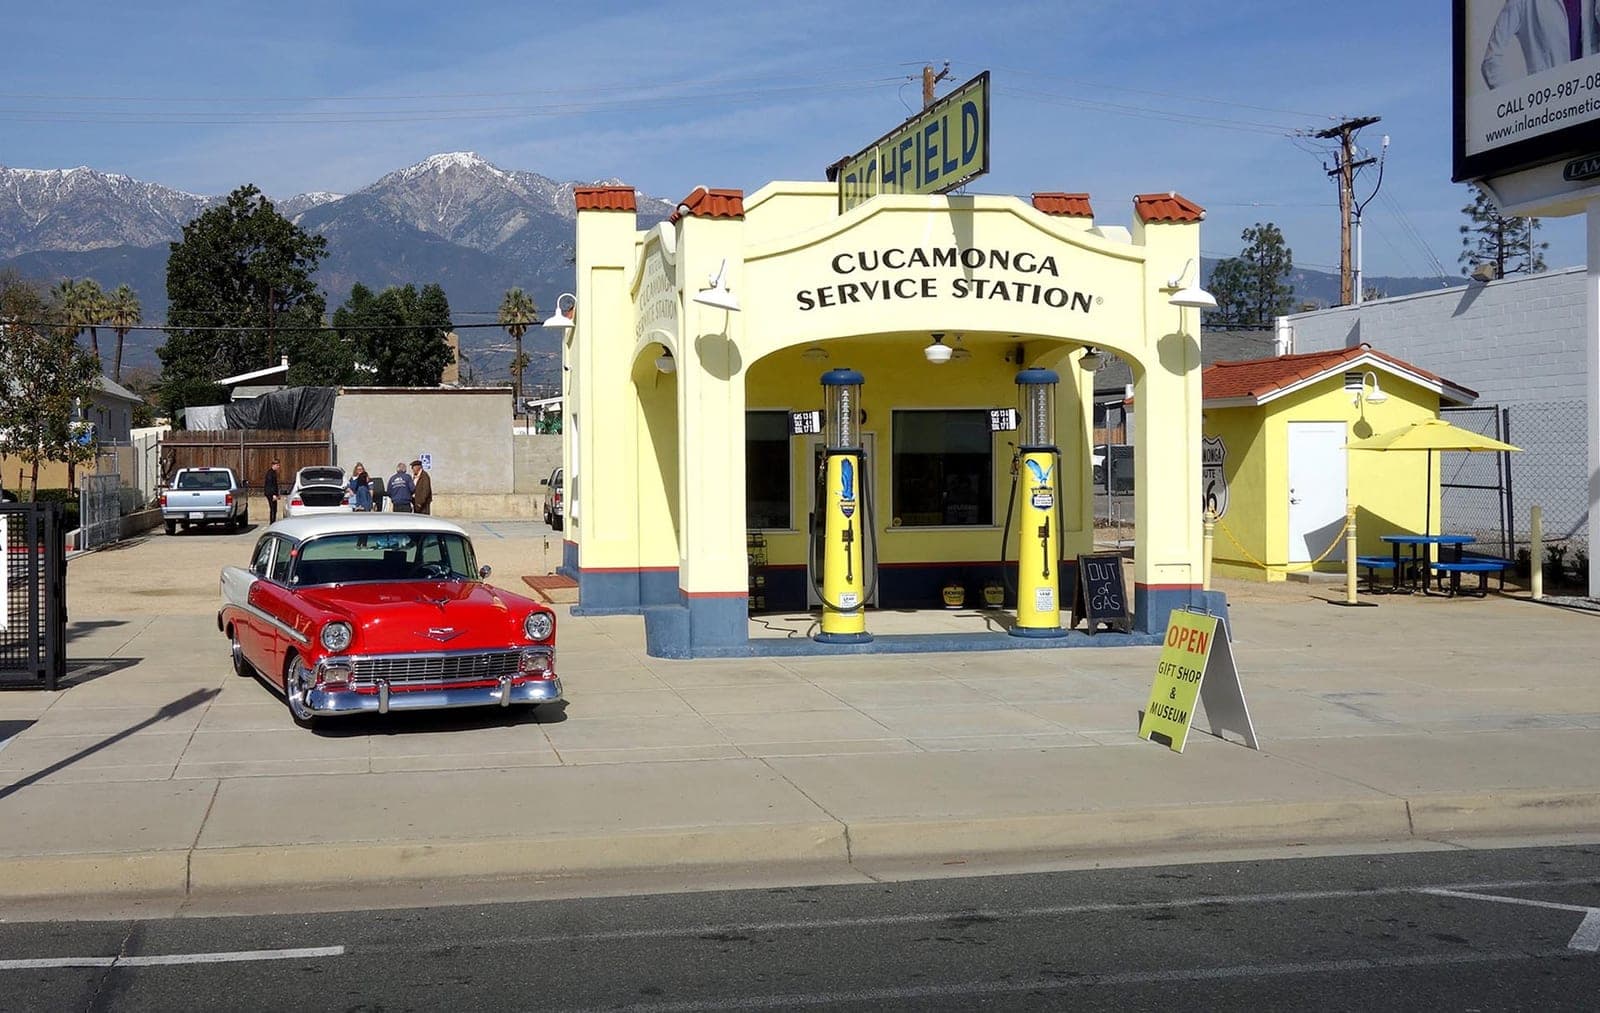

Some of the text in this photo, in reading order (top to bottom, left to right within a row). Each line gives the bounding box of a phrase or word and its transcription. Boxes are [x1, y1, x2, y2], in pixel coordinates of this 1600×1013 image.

[1497, 72, 1600, 118] CALL 909-987-08
[1486, 98, 1600, 142] www.inlandcosmetic
[832, 247, 1059, 277] CUCAMONGA
[797, 278, 1093, 313] SERVICE STATION
[1088, 563, 1115, 581] OUT
[1097, 582, 1111, 595] of
[1092, 594, 1120, 610] GAS
[1167, 625, 1208, 655] OPEN
[1158, 661, 1202, 684] GIFT SHOP
[1169, 687, 1176, 699] &
[1150, 701, 1187, 725] MUSEUM
